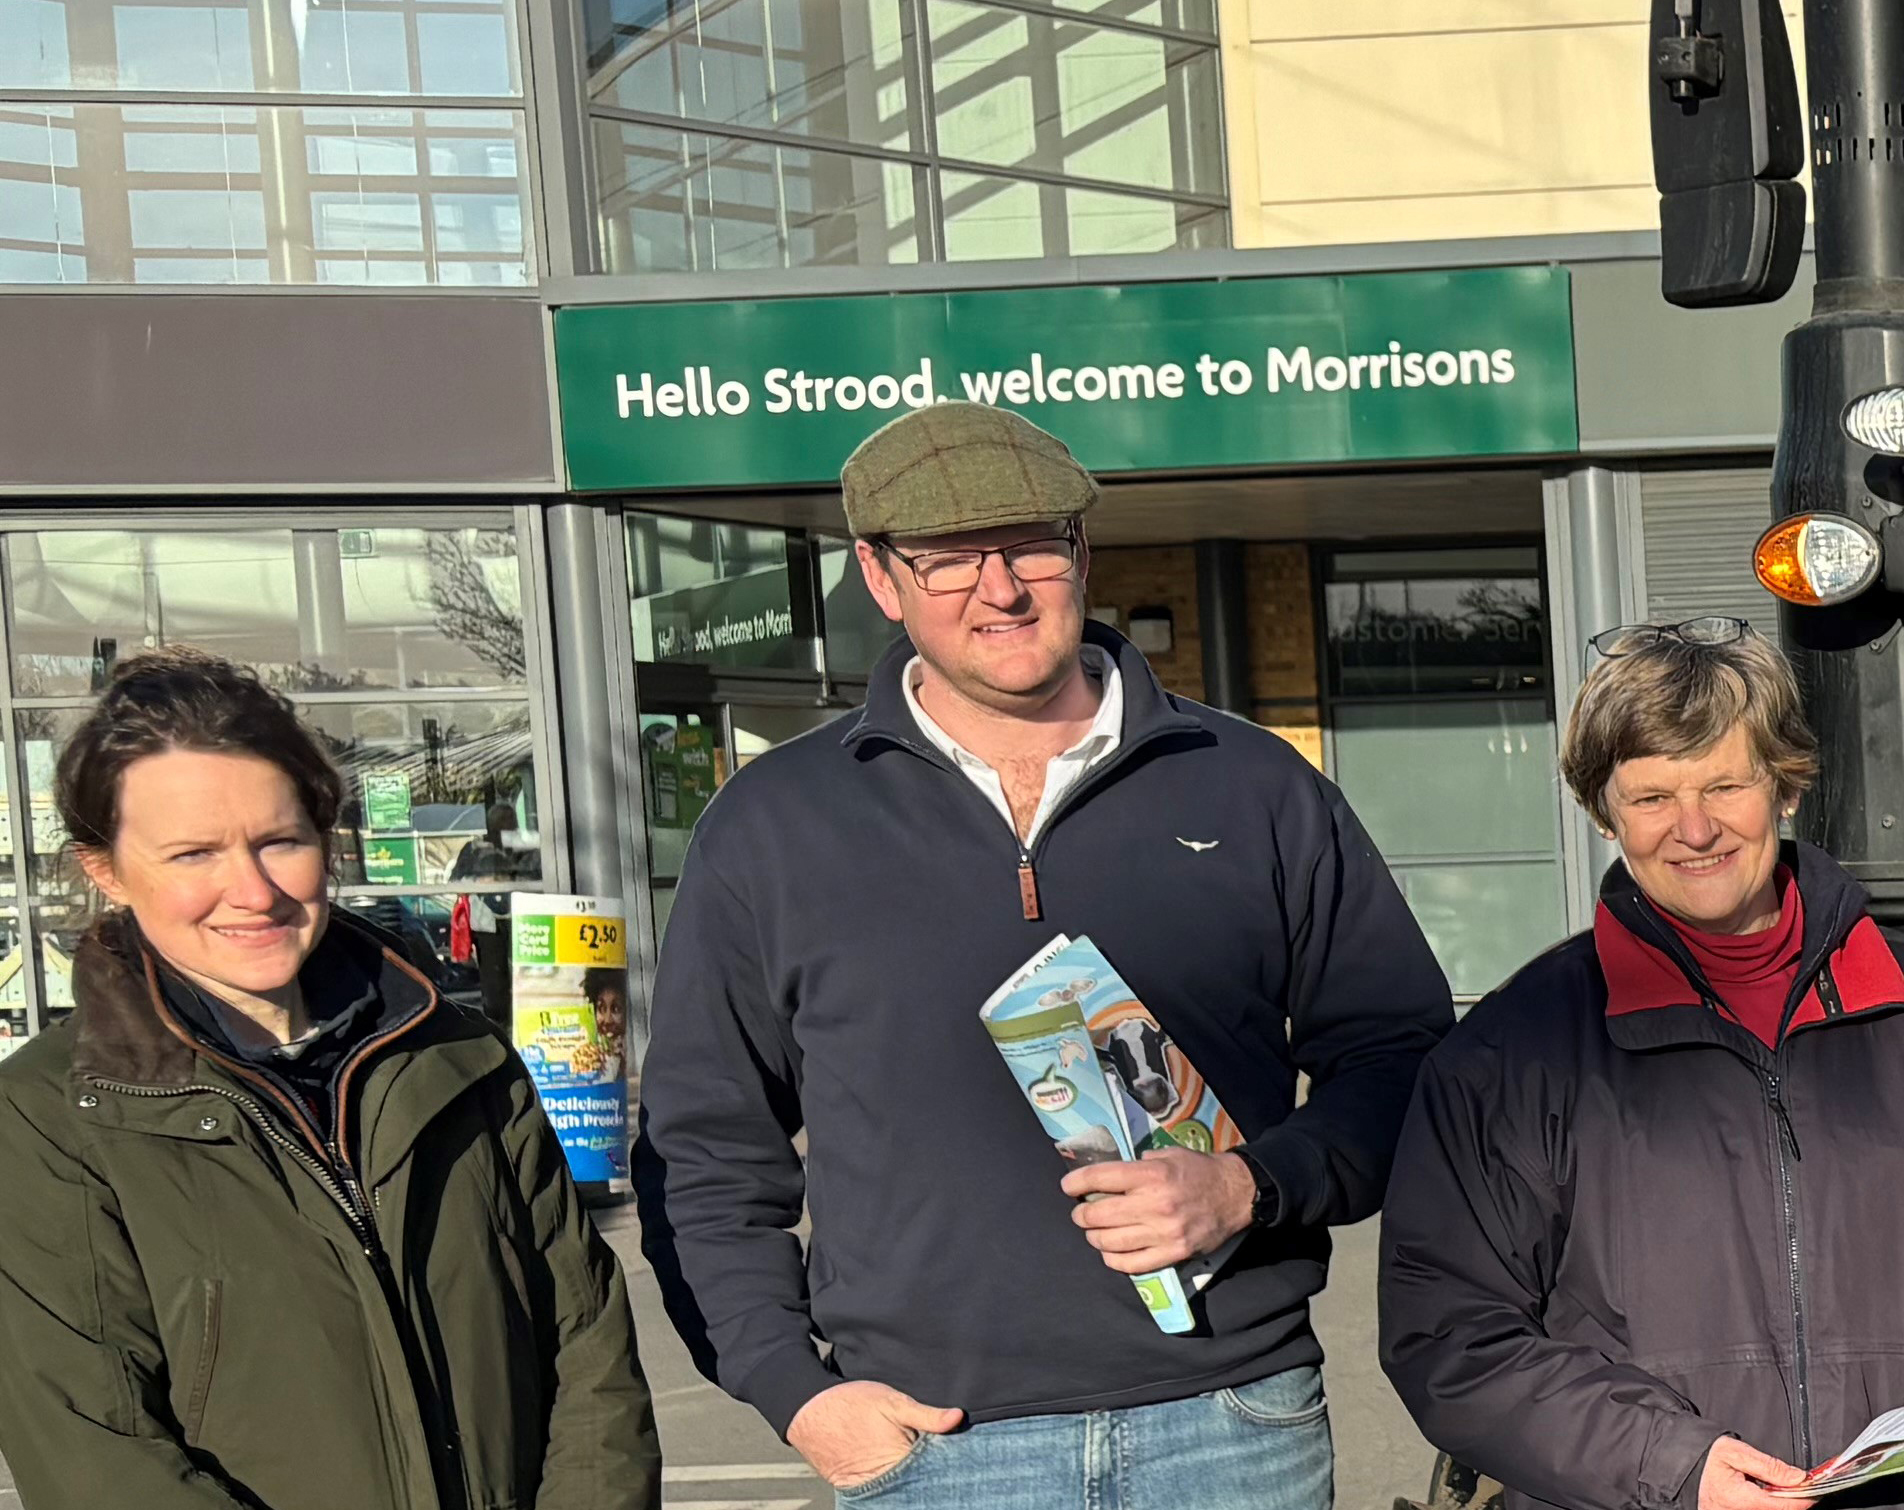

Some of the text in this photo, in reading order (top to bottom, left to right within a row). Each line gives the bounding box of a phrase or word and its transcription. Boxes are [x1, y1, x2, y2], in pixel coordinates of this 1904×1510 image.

[616, 365, 750, 419] Hello
[960, 352, 1185, 405] welcome
[1196, 353, 1253, 396] to
[1267, 340, 1516, 393] Morrisons
[579, 923, 617, 949] £2.50
[548, 1113, 580, 1130] igh
